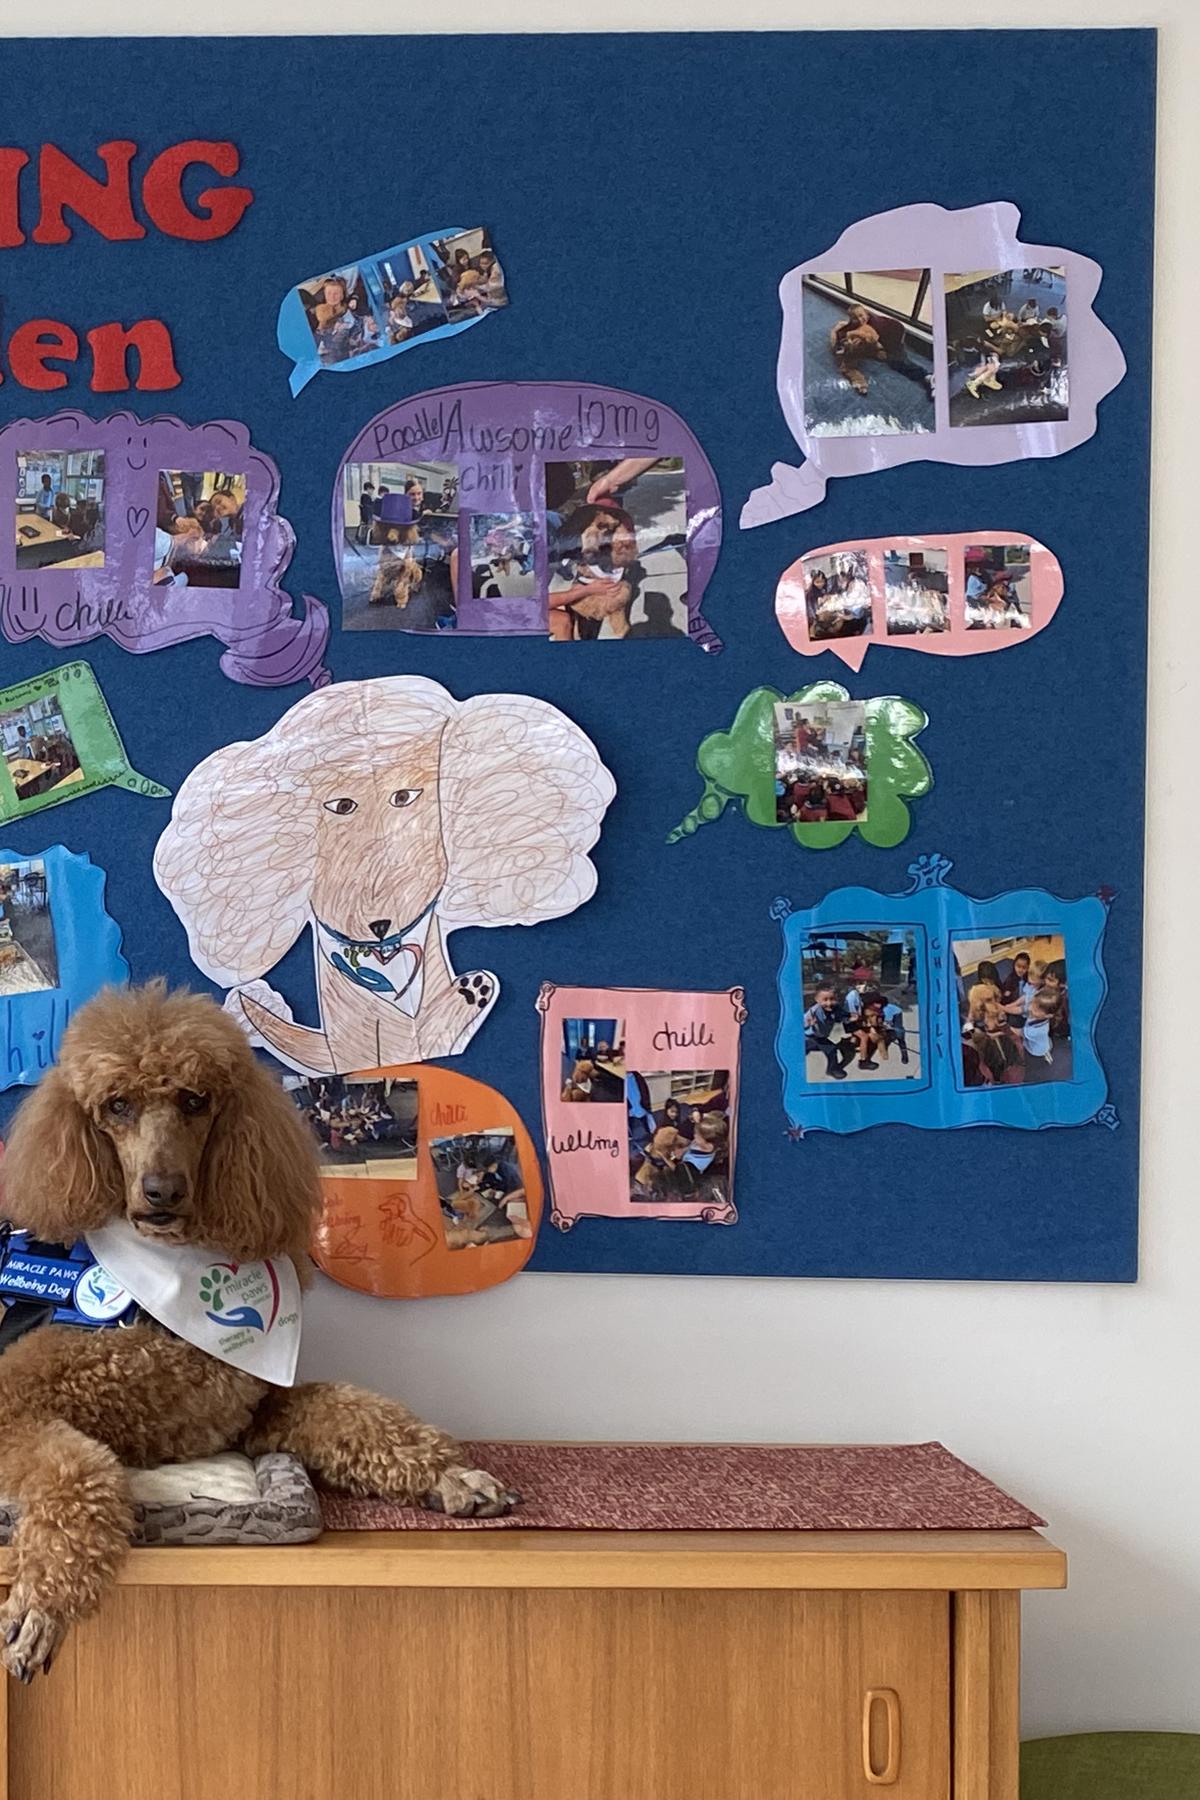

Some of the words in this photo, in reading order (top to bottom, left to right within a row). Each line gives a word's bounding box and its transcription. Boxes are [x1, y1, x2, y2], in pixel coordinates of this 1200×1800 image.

[6, 1260, 48, 1275] MIRACLE
[48, 1266, 80, 1281] PAWS
[0, 1273, 47, 1295] Wellbeing
[48, 1282, 71, 1298] Dog
[225, 1270, 263, 1295] miracle
[241, 1282, 269, 1304] paws
